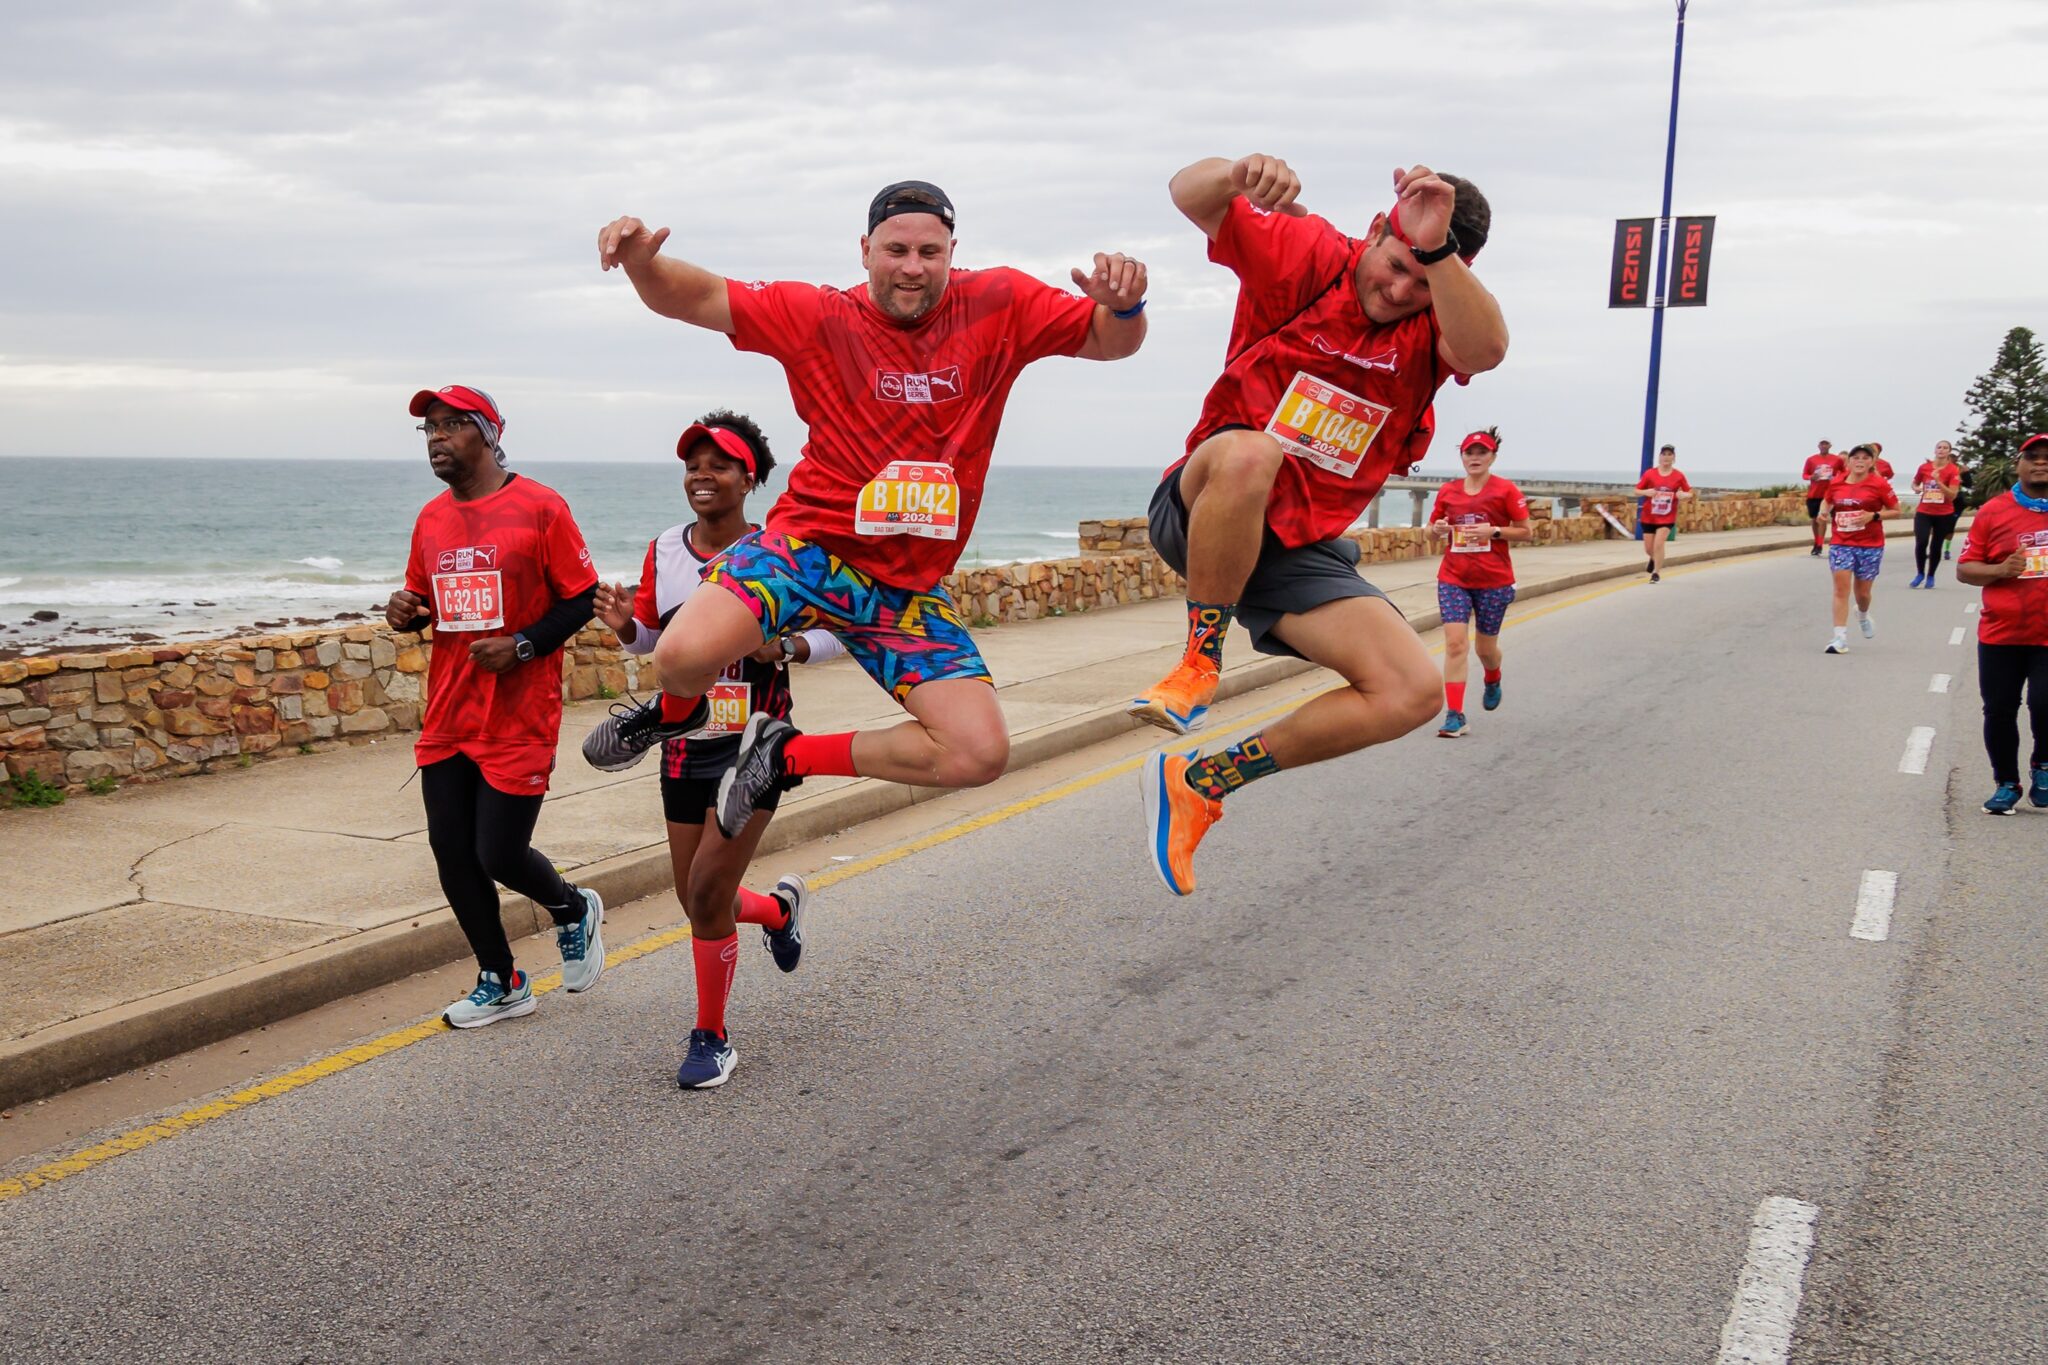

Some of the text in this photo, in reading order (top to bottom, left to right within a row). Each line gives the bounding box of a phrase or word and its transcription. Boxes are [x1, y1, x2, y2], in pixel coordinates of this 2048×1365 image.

[1621, 226, 1643, 300] ISUZU
[1681, 224, 1703, 299] ISUZU
[906, 377, 928, 387] RUN
[1289, 398, 1369, 451] B 1043
[1311, 439, 1342, 457] 2024
[873, 481, 951, 515] B 1042
[902, 512, 933, 524] 2024
[458, 550, 473, 559] RUN
[461, 612, 482, 620] 2024
